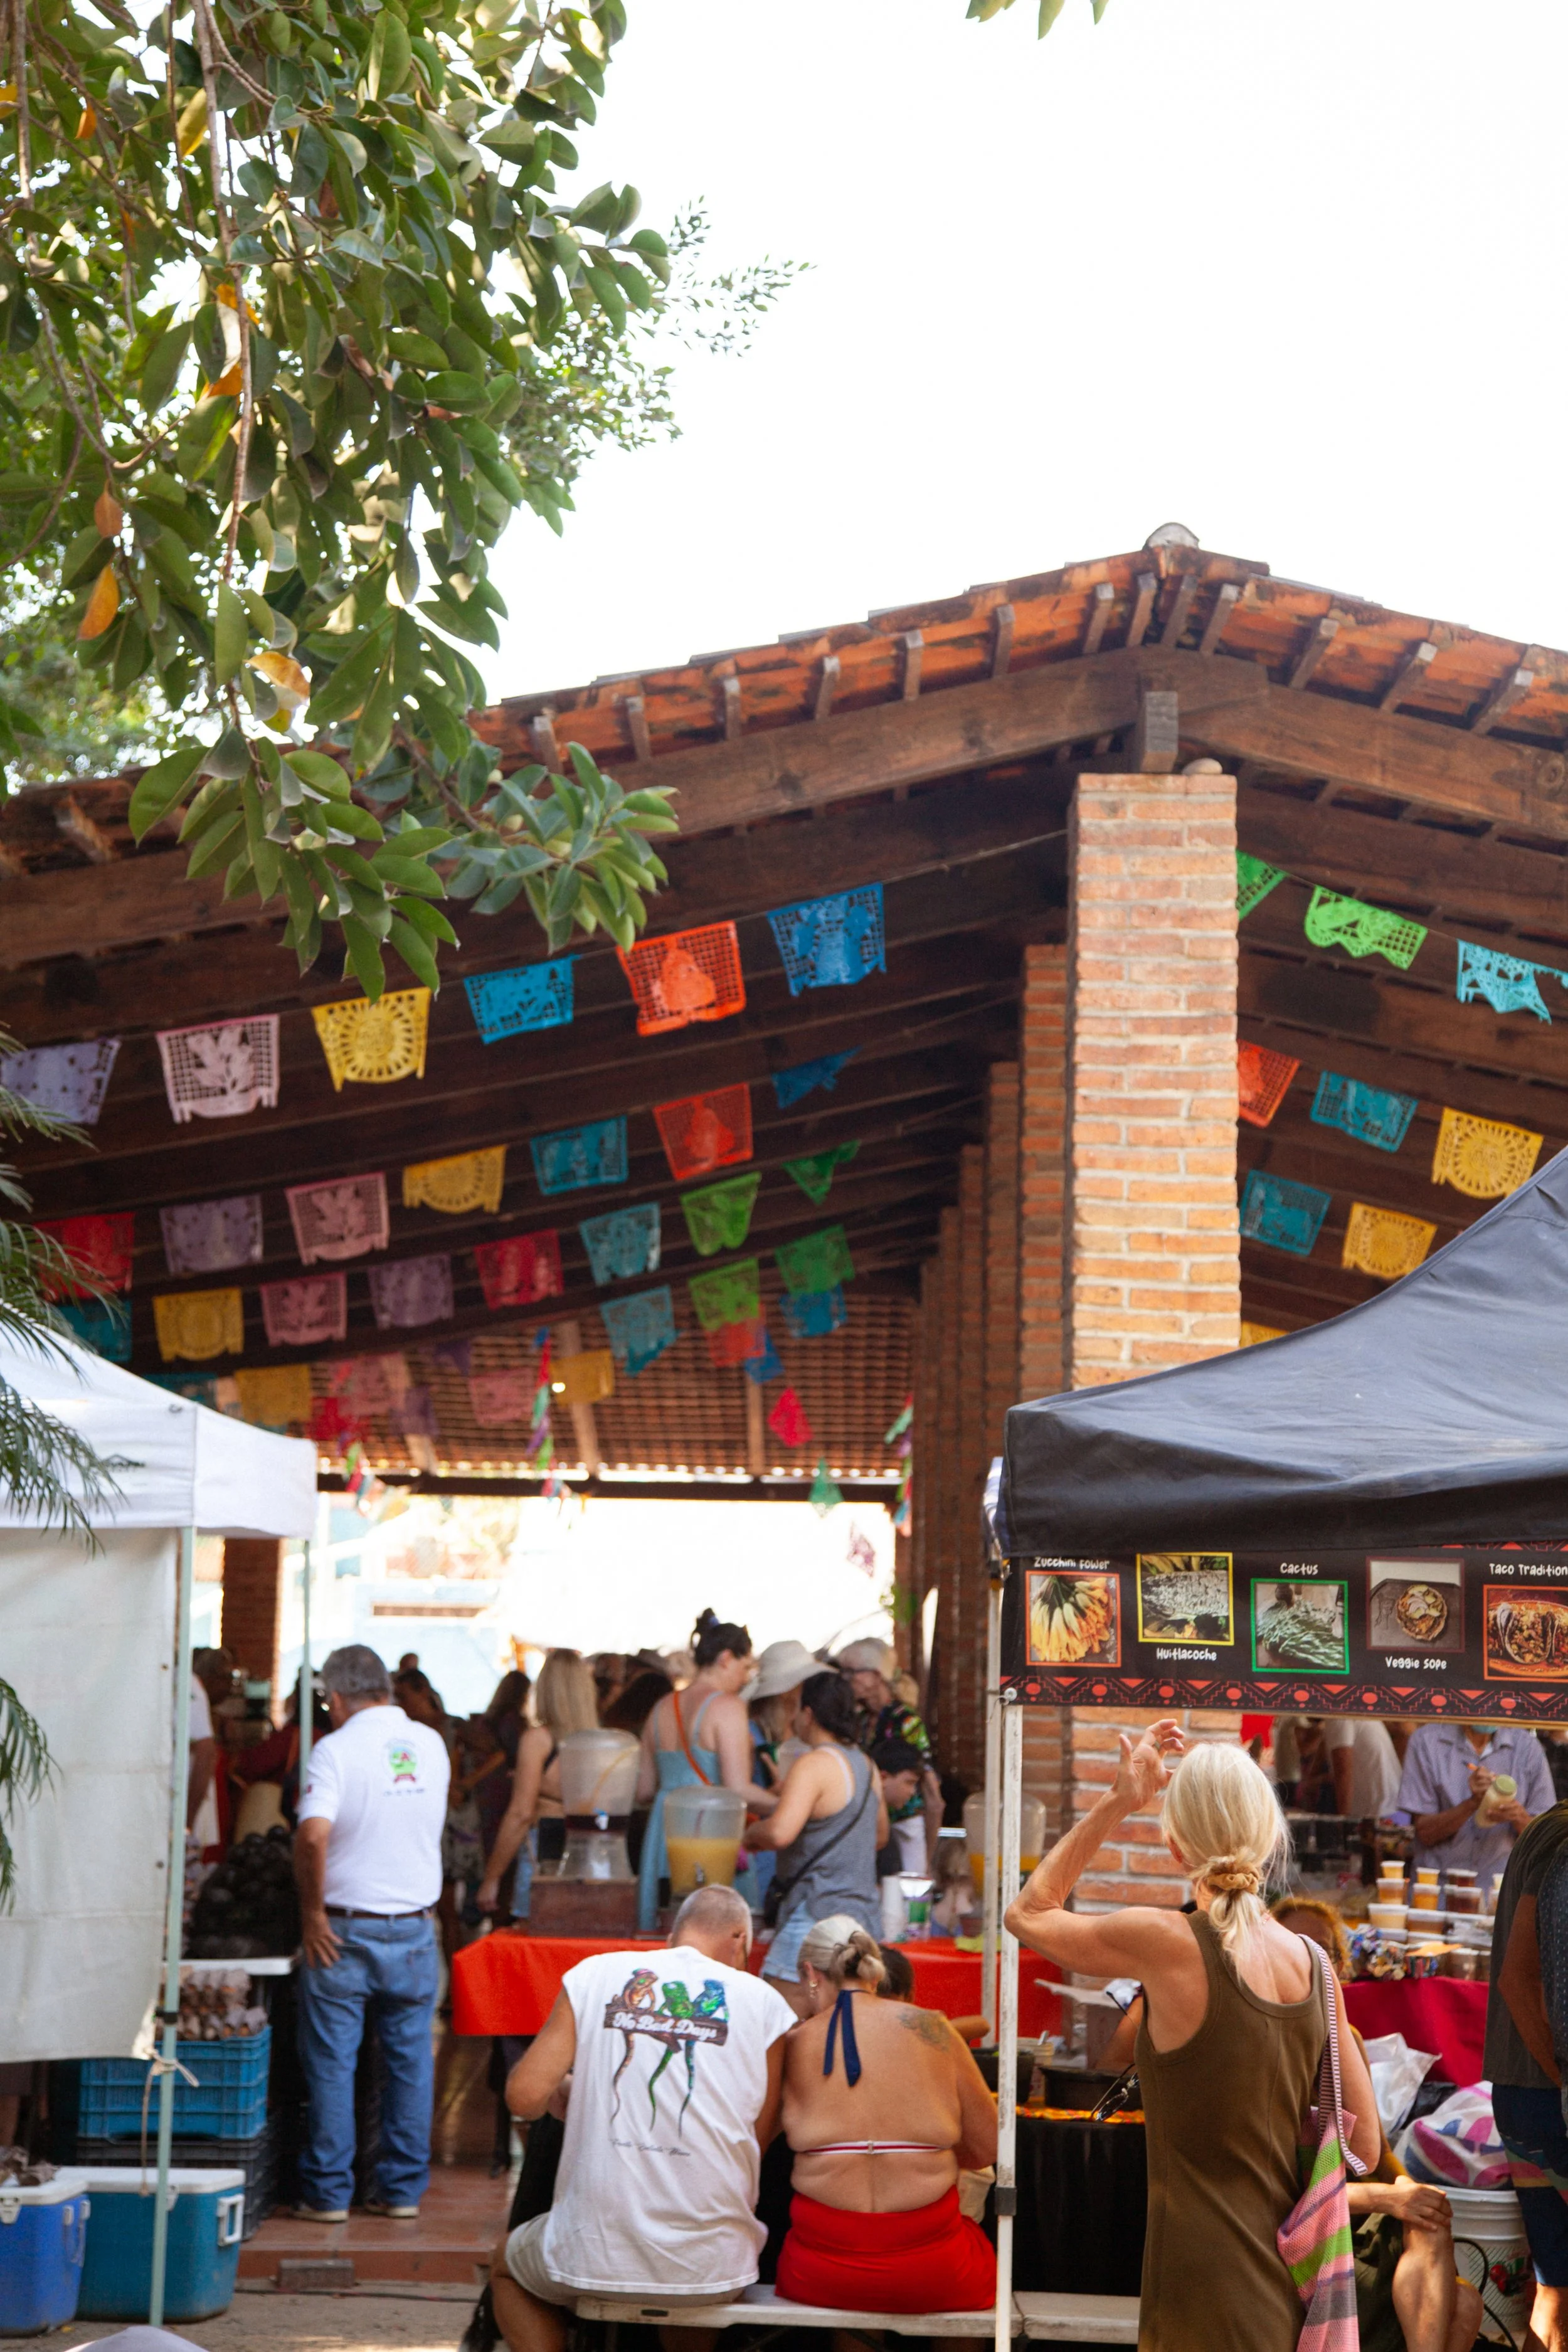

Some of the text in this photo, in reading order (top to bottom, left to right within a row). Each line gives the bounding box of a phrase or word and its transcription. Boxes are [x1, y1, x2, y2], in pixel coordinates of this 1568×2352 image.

[1034, 1556, 1076, 1568] Zucchini
[1280, 1562, 1318, 1576] Cactus
[1489, 1563, 1515, 1576] Taco
[1156, 1647, 1217, 1661] Huitlacoche
[1385, 1656, 1420, 1669] Veggie
[612, 2011, 717, 2042] No Bad Days
